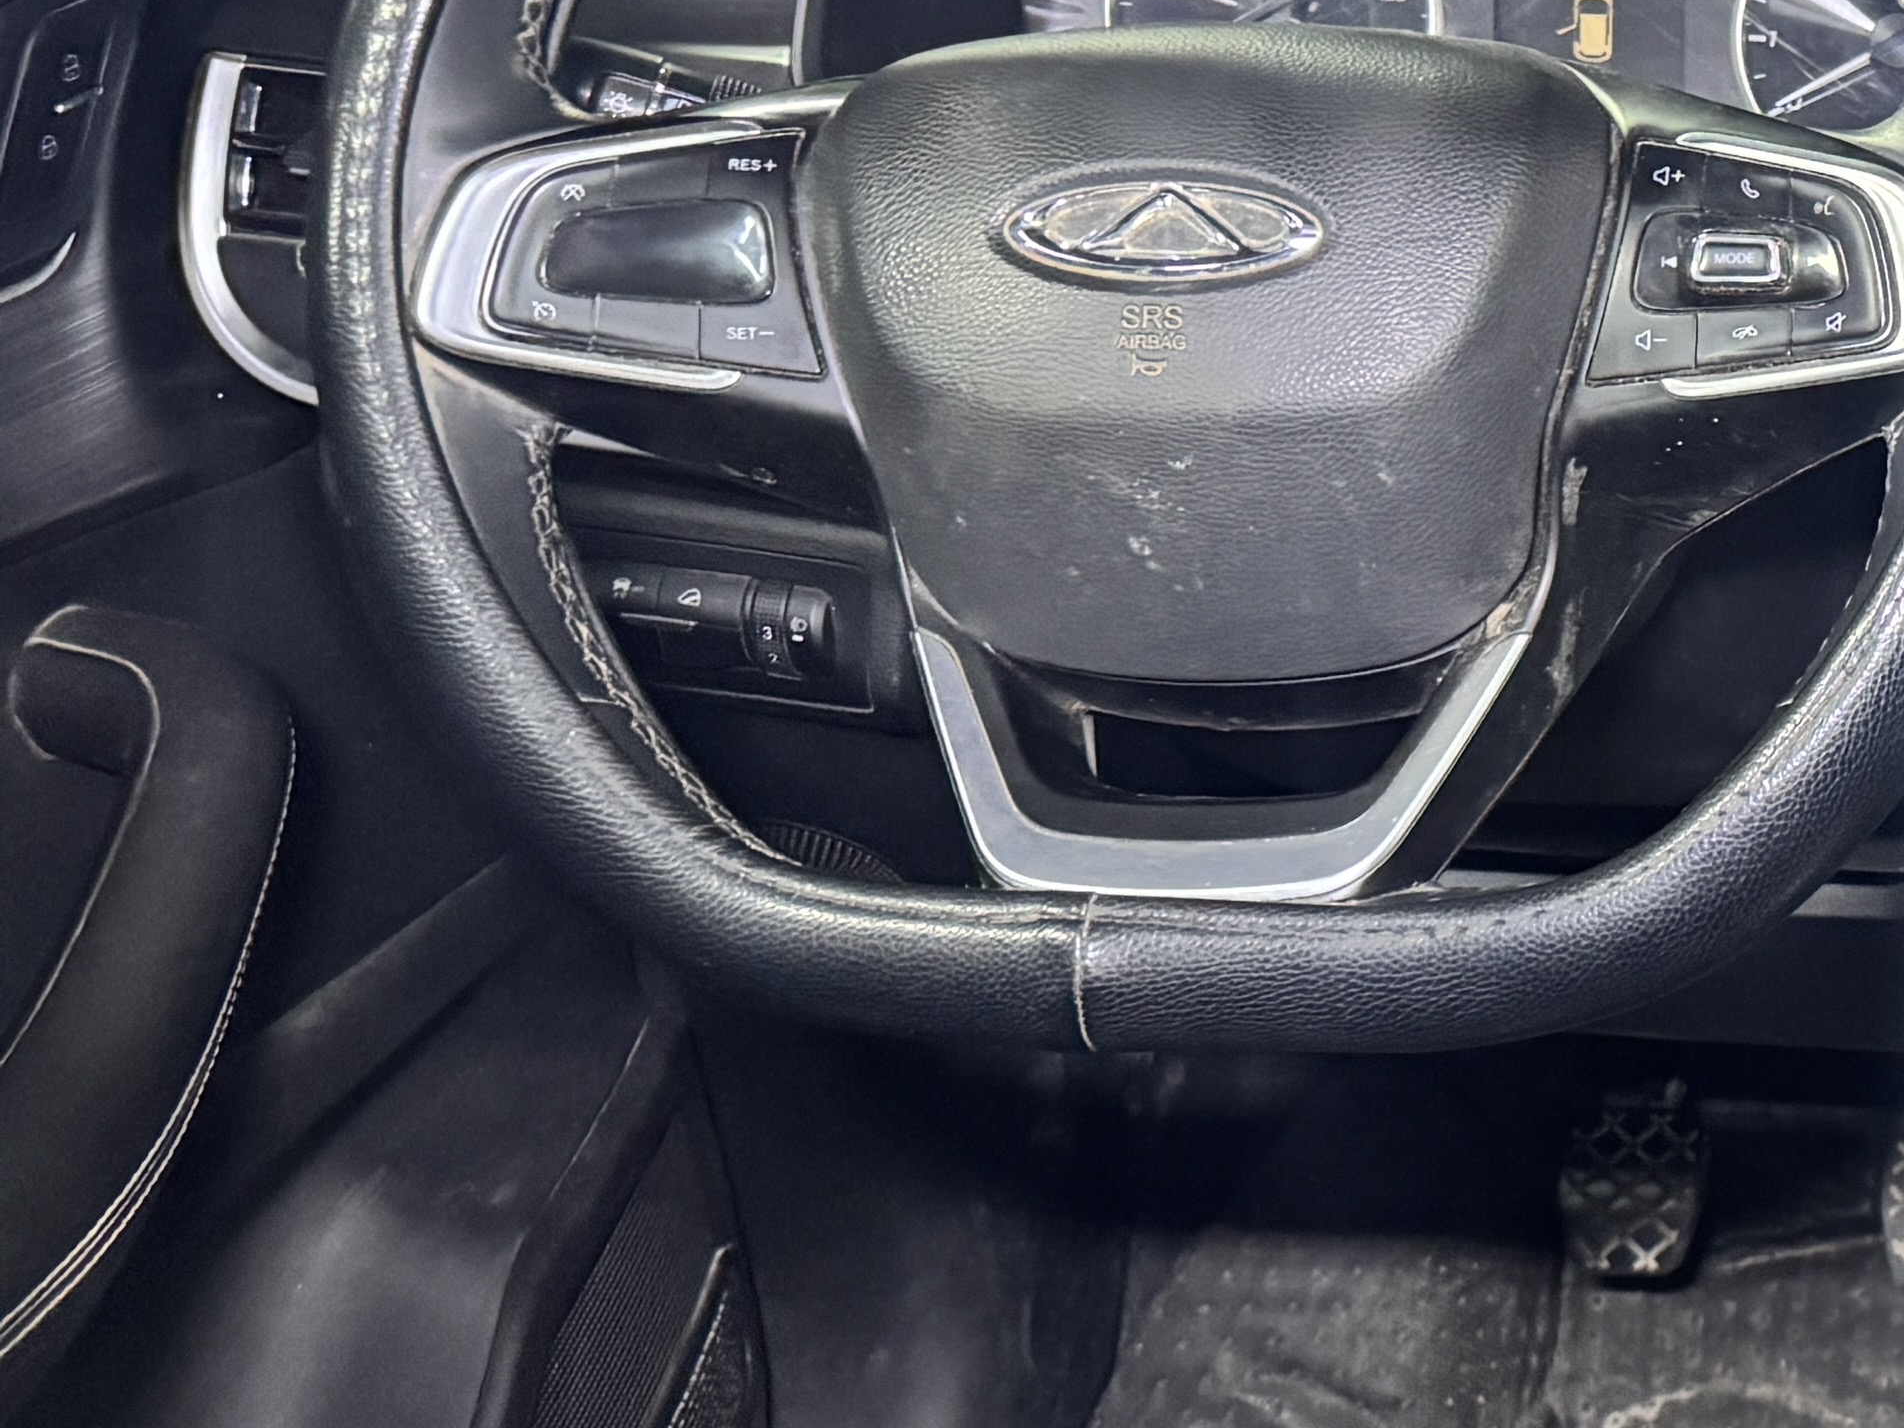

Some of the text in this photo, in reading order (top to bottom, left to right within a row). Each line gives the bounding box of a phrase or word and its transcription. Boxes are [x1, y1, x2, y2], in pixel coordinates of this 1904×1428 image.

[1713, 252, 1756, 265] MODE
[1121, 305, 1184, 330] SRS
[1116, 334, 1187, 350] AIRBAG
[762, 626, 773, 640] 3
